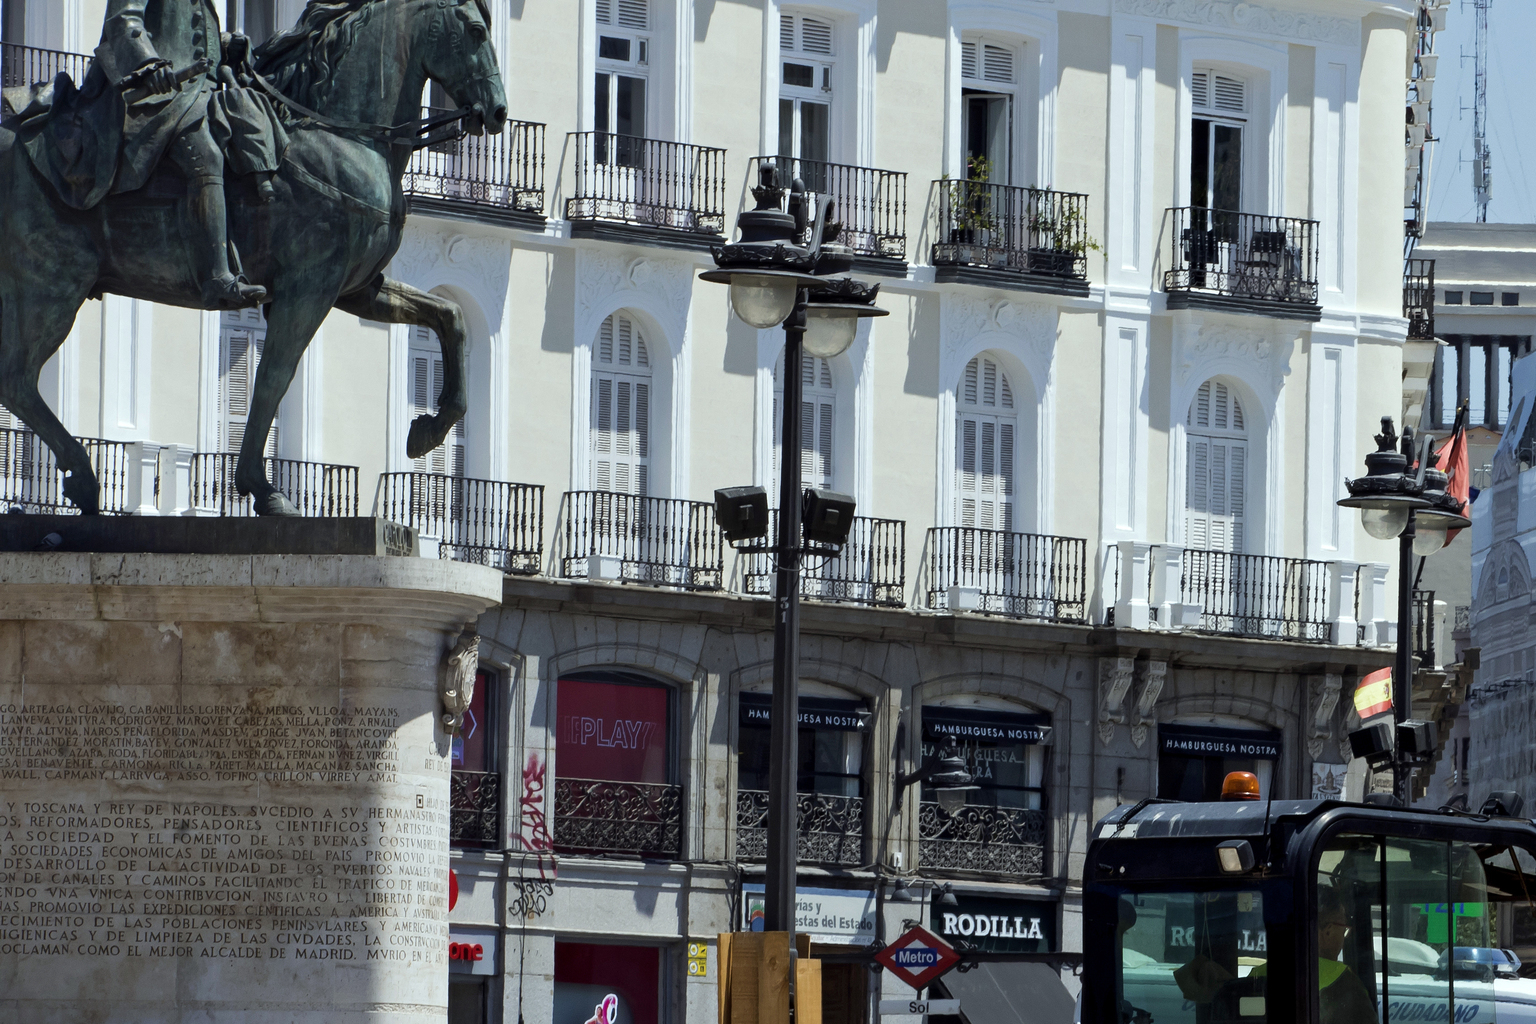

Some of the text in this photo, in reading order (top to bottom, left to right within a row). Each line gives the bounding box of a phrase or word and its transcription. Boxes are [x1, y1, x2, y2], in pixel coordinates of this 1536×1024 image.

[57, 715, 106, 726] VENTVRA
[748, 708, 864, 727] HAMUESA NOSTRA
[253, 728, 290, 738] JORGE
[580, 716, 642, 749] PLAY
[934, 723, 1044, 741] HAMBURGUESA NOSTRA
[1166, 739, 1277, 755] HAMBURGUESA NOSTRA
[319, 773, 361, 782] VIRREY
[7, 802, 15, 813] Y
[24, 802, 85, 814] TOSCANA
[110, 803, 135, 815] REY
[144, 804, 163, 815] DE
[250, 805, 314, 818] SVCEDIO
[341, 807, 359, 819] SV
[163, 818, 262, 830] PENSADORES
[275, 820, 368, 833] CIENTIFICOS
[26, 830, 114, 843] SOCIEDAD
[148, 833, 163, 844] EL
[173, 833, 241, 845] FOMENTO
[250, 835, 268, 846] DE
[278, 835, 305, 846] LAS
[314, 835, 368, 847] BVENAS
[11, 844, 424, 864] SOCIEDADES ECONOMICAS DE AMIGOS DEL PAIS PROMOVIO
[4, 858, 106, 871] DESARROLLO
[118, 860, 137, 872] DE
[148, 861, 166, 872] LA
[179, 861, 261, 873] ACTIVIDAD
[270, 863, 287, 874] DE
[297, 863, 324, 875] LOS
[333, 864, 393, 876] PVERTOS
[24, 872, 41, 884] DE
[51, 874, 115, 885] CANALES
[141, 875, 206, 887] CAMINOS
[313, 877, 327, 889] EL
[401, 879, 412, 891] DE
[50, 887, 78, 899] VNA
[89, 888, 133, 900] VNICA
[365, 892, 413, 904] LIBERTAD
[30, 902, 398, 918] PROMOVIO LAS EXPEDICIONES CIENTIFICAS AMERICA
[94, 916, 114, 928] DE
[124, 917, 152, 928] LAS
[162, 917, 262, 929] POBLACIONES
[272, 919, 368, 931] PENINSVLARES
[795, 914, 873, 931] estas del Estado
[942, 912, 1044, 940] RODILLA
[107, 930, 125, 942] DE
[135, 931, 204, 943] LIMPIEZA
[213, 932, 232, 944] DE
[240, 933, 267, 944] LAS
[364, 934, 381, 946] LA
[77, 944, 120, 956] COMO
[127, 945, 142, 957] EL
[149, 945, 193, 957] MEJOR
[200, 946, 262, 958] ALCALDE
[270, 947, 287, 959] DE
[366, 949, 407, 961] MVRIO
[899, 951, 934, 964] Metro
[908, 1001, 930, 1014] Sol
